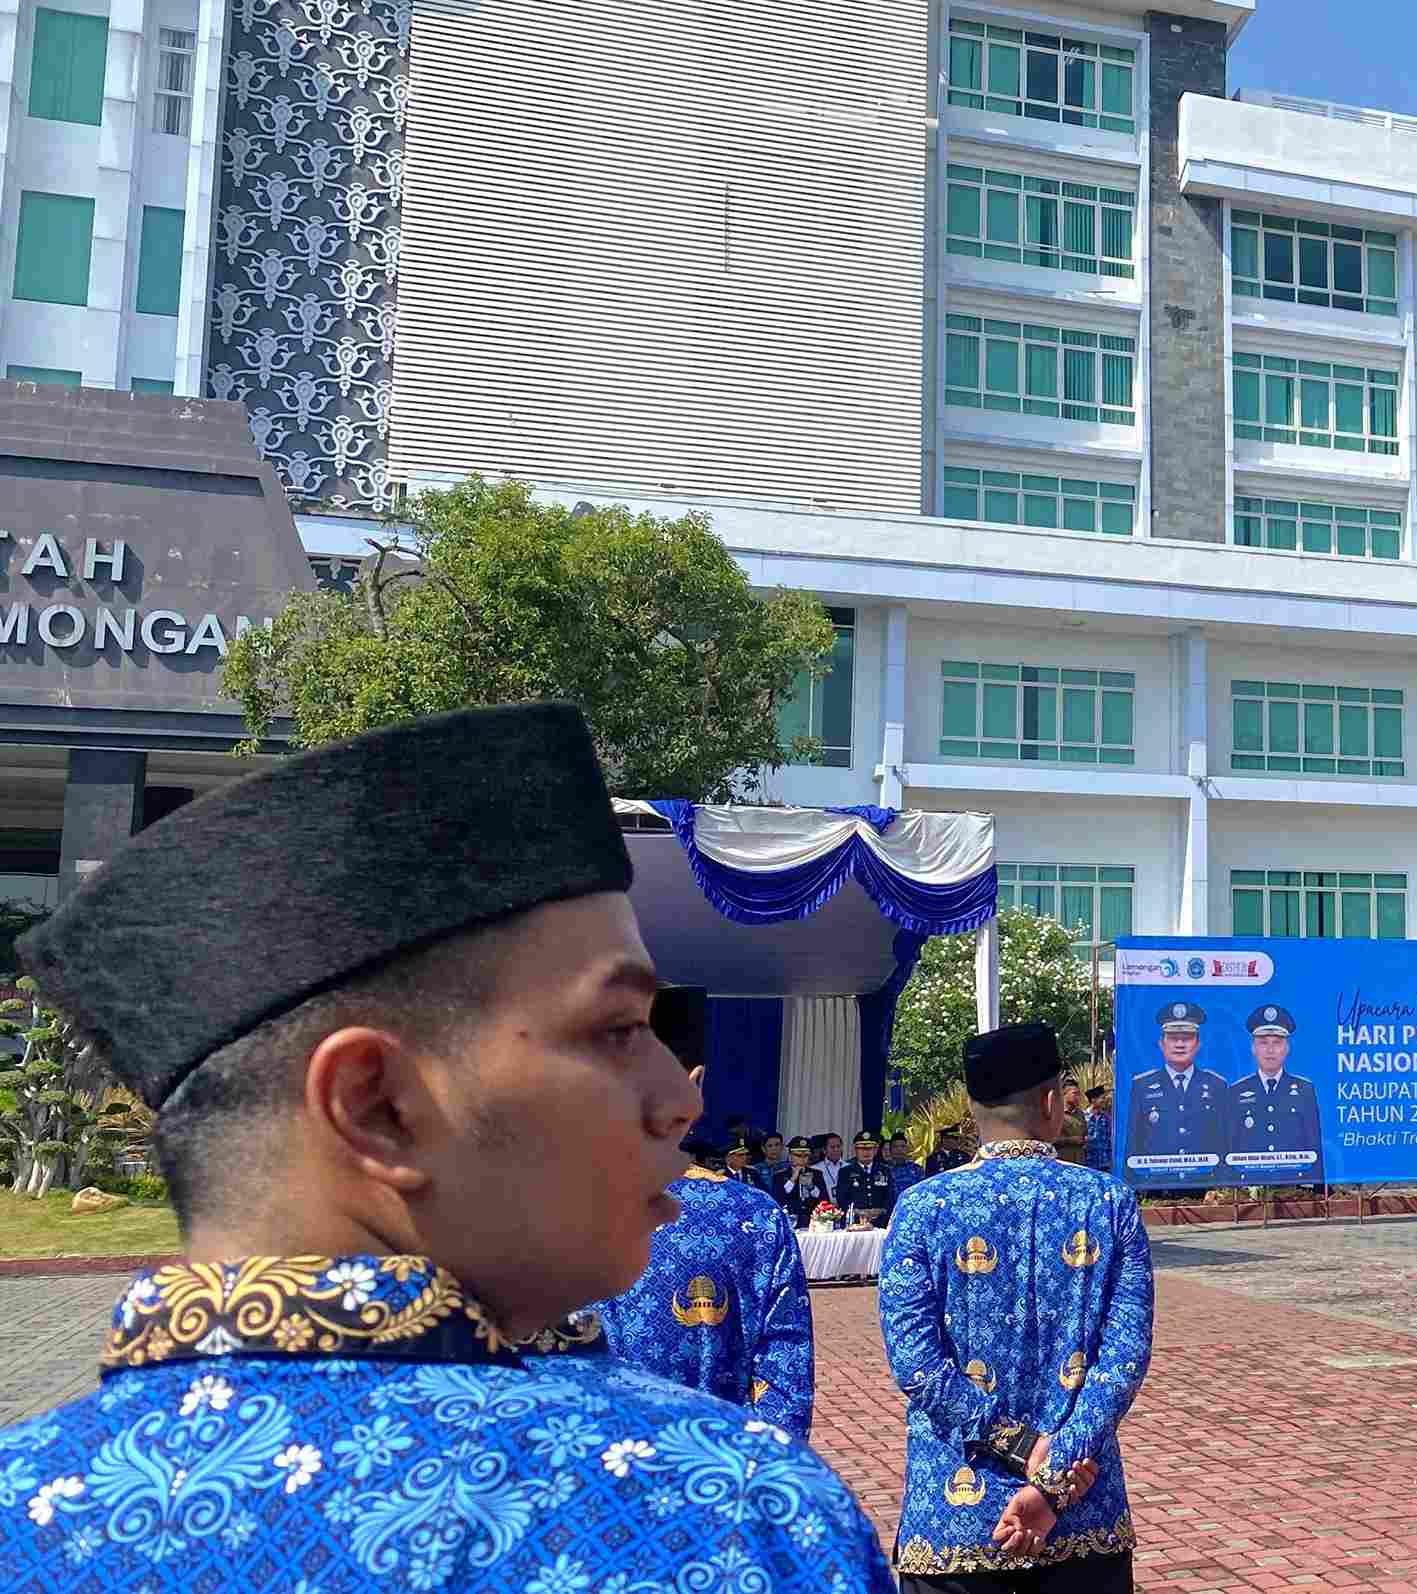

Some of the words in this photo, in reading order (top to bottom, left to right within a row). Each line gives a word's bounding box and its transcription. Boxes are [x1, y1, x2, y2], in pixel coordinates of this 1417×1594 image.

[0, 530, 126, 581] AH
[1337, 1025, 1395, 1045] HARI
[1337, 1105, 1404, 1122] TAHUN
